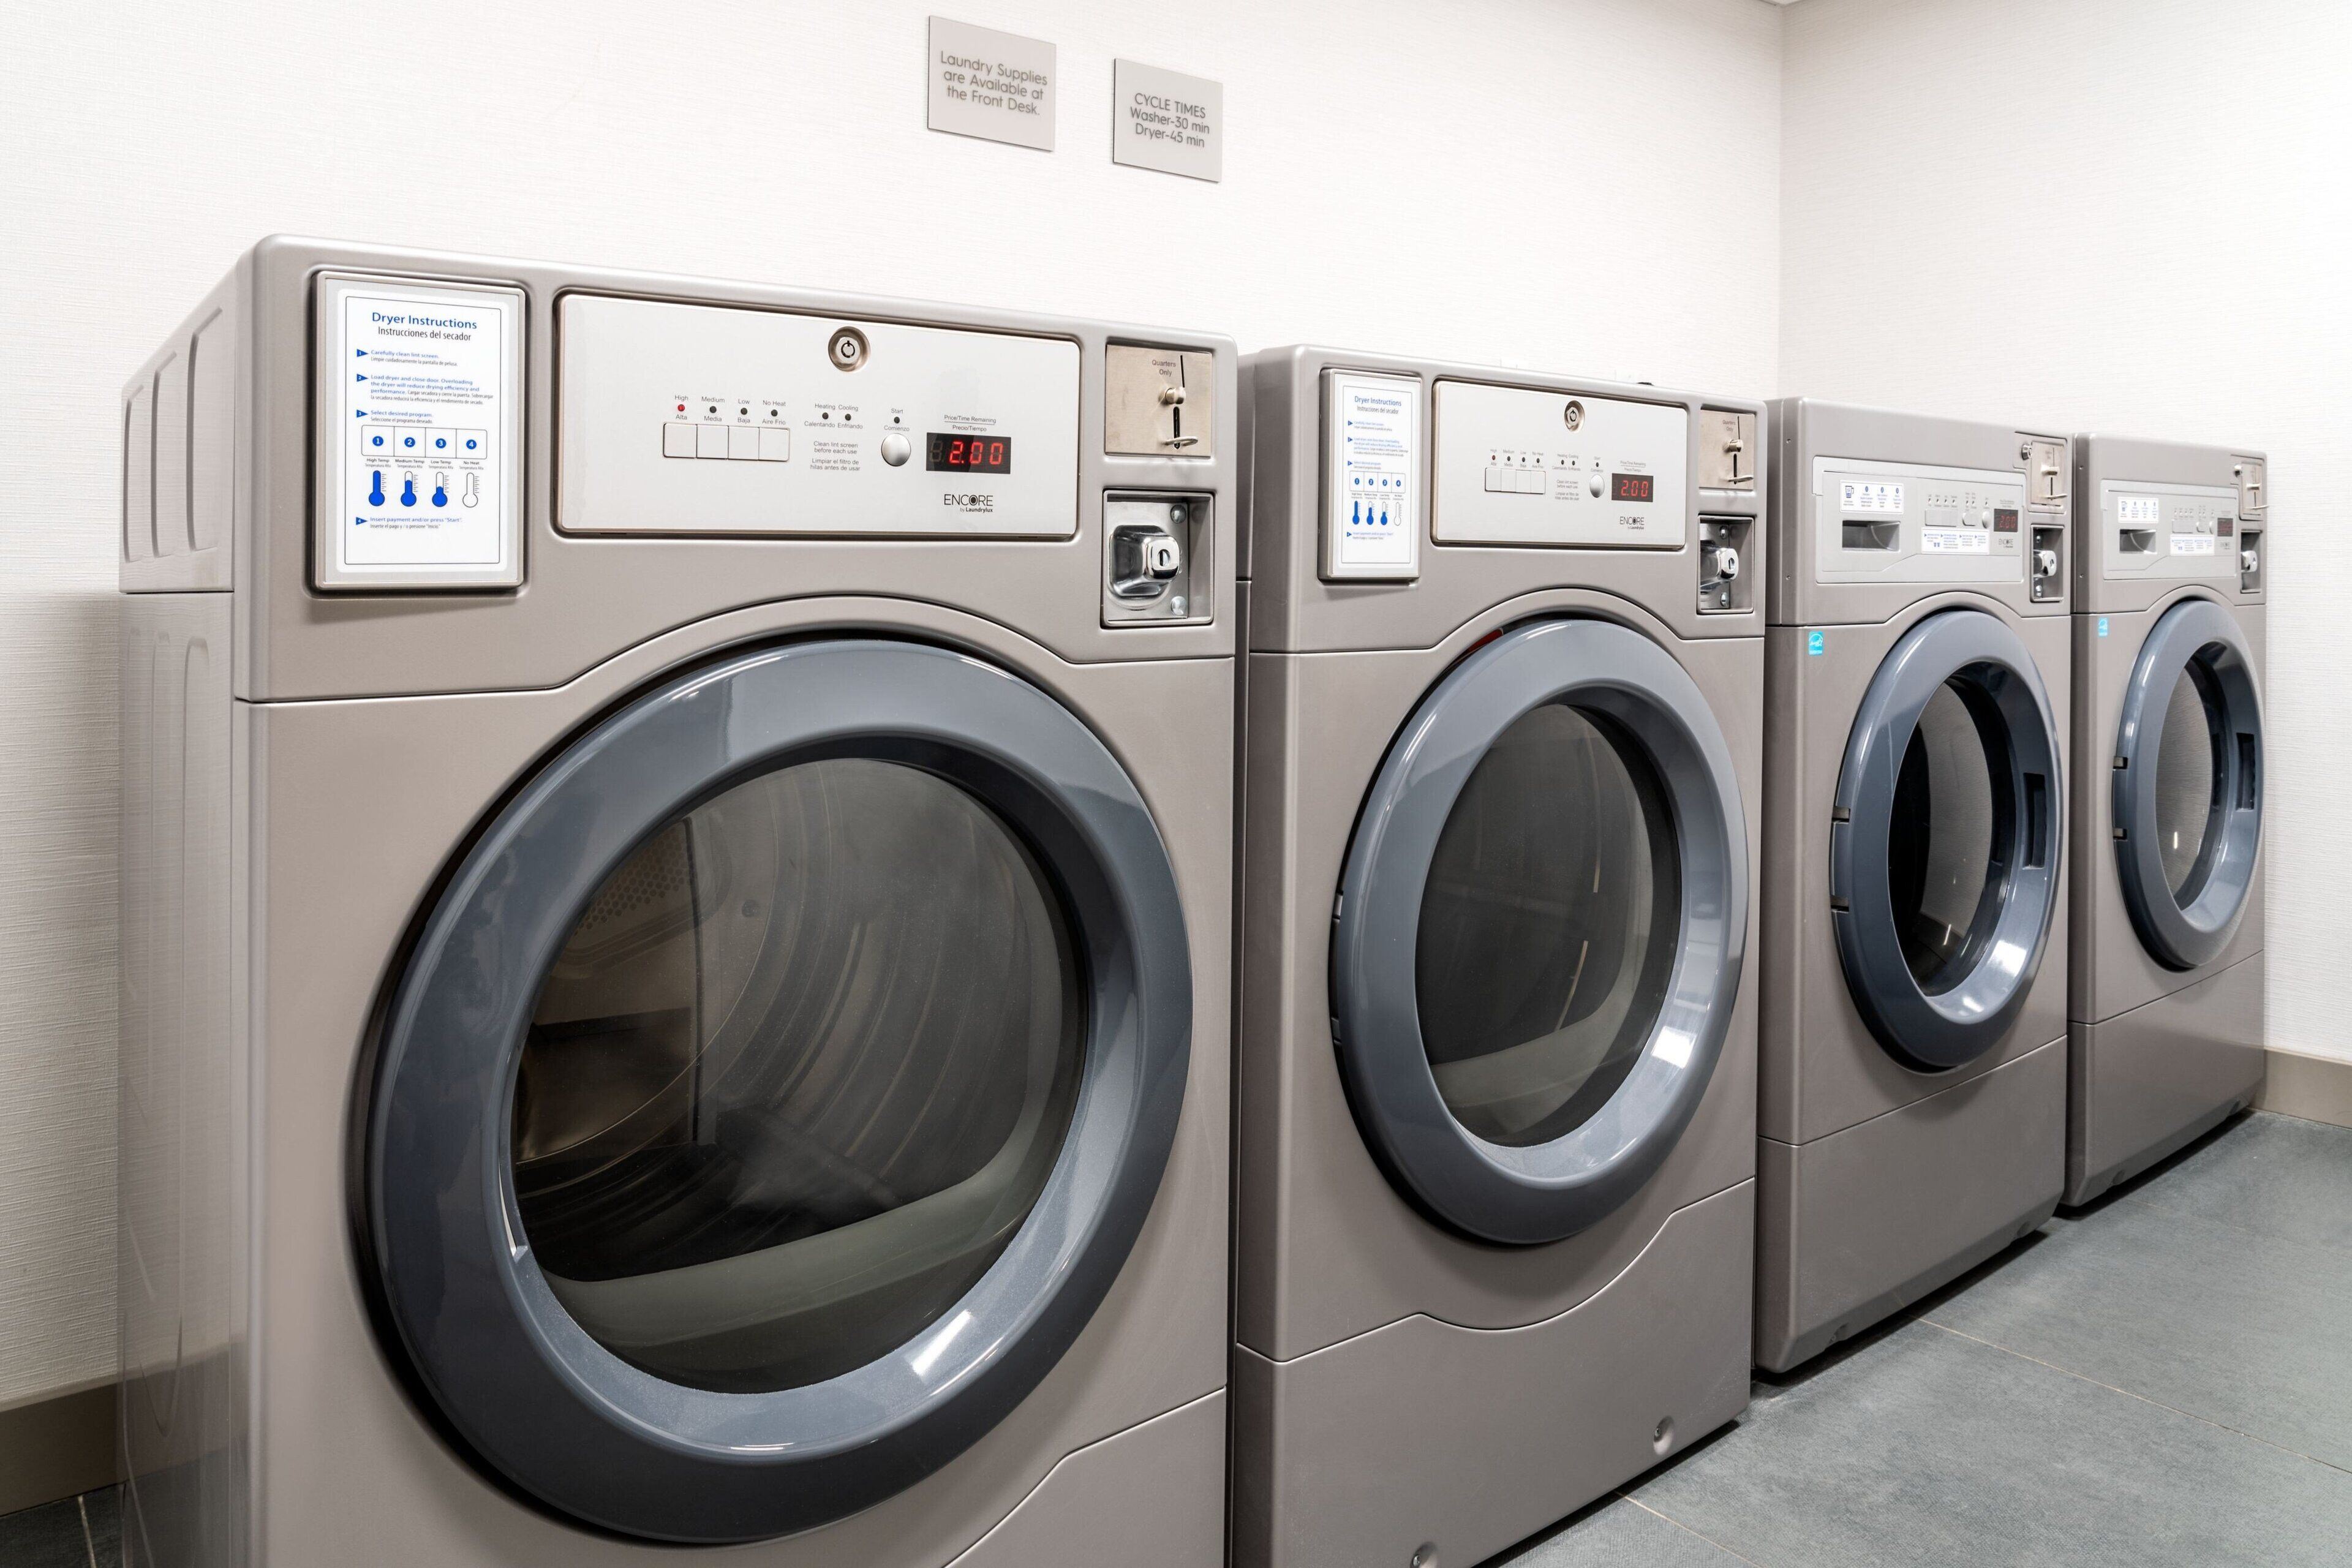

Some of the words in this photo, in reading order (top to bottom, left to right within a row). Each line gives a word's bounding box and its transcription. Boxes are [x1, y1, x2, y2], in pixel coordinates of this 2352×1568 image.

[940, 50, 992, 76] Laundry
[997, 63, 1047, 86] Supplies
[944, 70, 966, 85] are
[970, 74, 1027, 97] Available
[1032, 88, 1044, 100] at
[947, 85, 967, 101] the
[972, 90, 1003, 108] Front
[1008, 98, 1040, 116] Desk.
[1134, 93, 1170, 111] CYCLE
[1174, 101, 1206, 119] TIMES
[1130, 107, 1188, 130] Washer-30
[1192, 120, 1210, 134] min
[1135, 123, 1184, 144] Dryer-45
[1186, 134, 1205, 148] min
[372, 312, 405, 325] Dryer
[409, 315, 477, 329] Instructions
[378, 326, 428, 338] Instrucciones
[430, 330, 441, 339] del
[443, 333, 471, 341] secador
[1152, 359, 1176, 368] Quarters
[1355, 396, 1369, 404] Dryer
[1371, 398, 1402, 406] Instructions
[949, 441, 1004, 465] 2.00
[1621, 480, 1648, 497] 2.00
[944, 493, 993, 507] ENCORE
[1620, 516, 1645, 525] ENCORE
